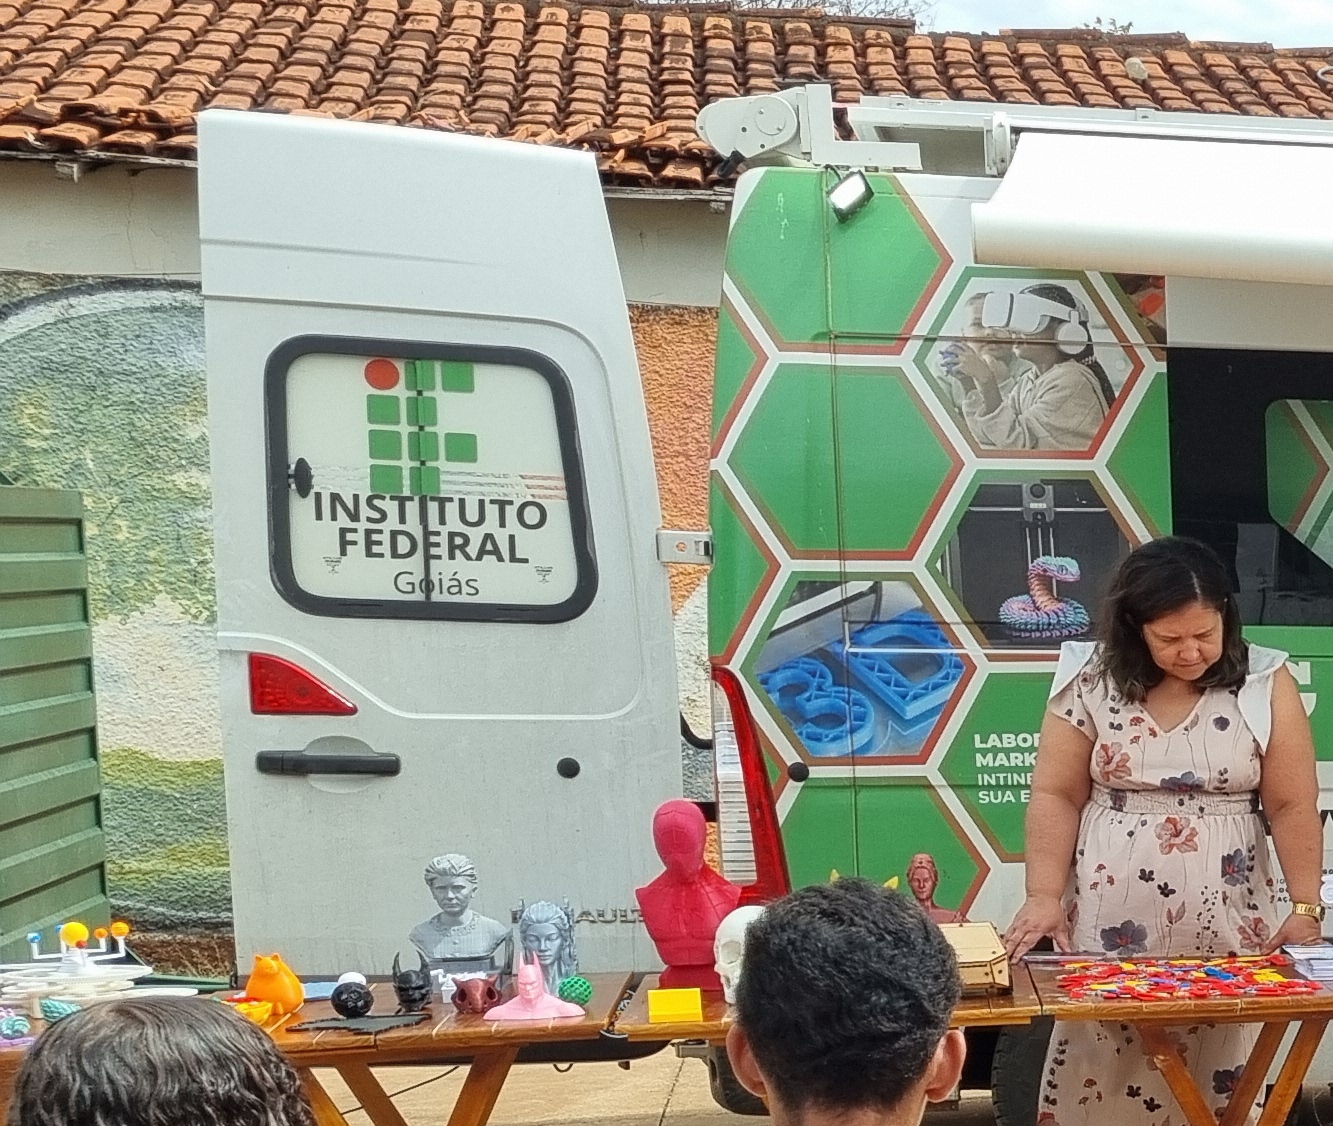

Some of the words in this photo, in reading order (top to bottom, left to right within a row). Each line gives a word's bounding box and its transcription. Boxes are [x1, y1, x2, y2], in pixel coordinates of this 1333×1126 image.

[313, 491, 548, 529] INSTITUTO
[338, 527, 530, 563] FEDERAL
[393, 571, 480, 597] Goiás
[978, 790, 1016, 804] SUA
